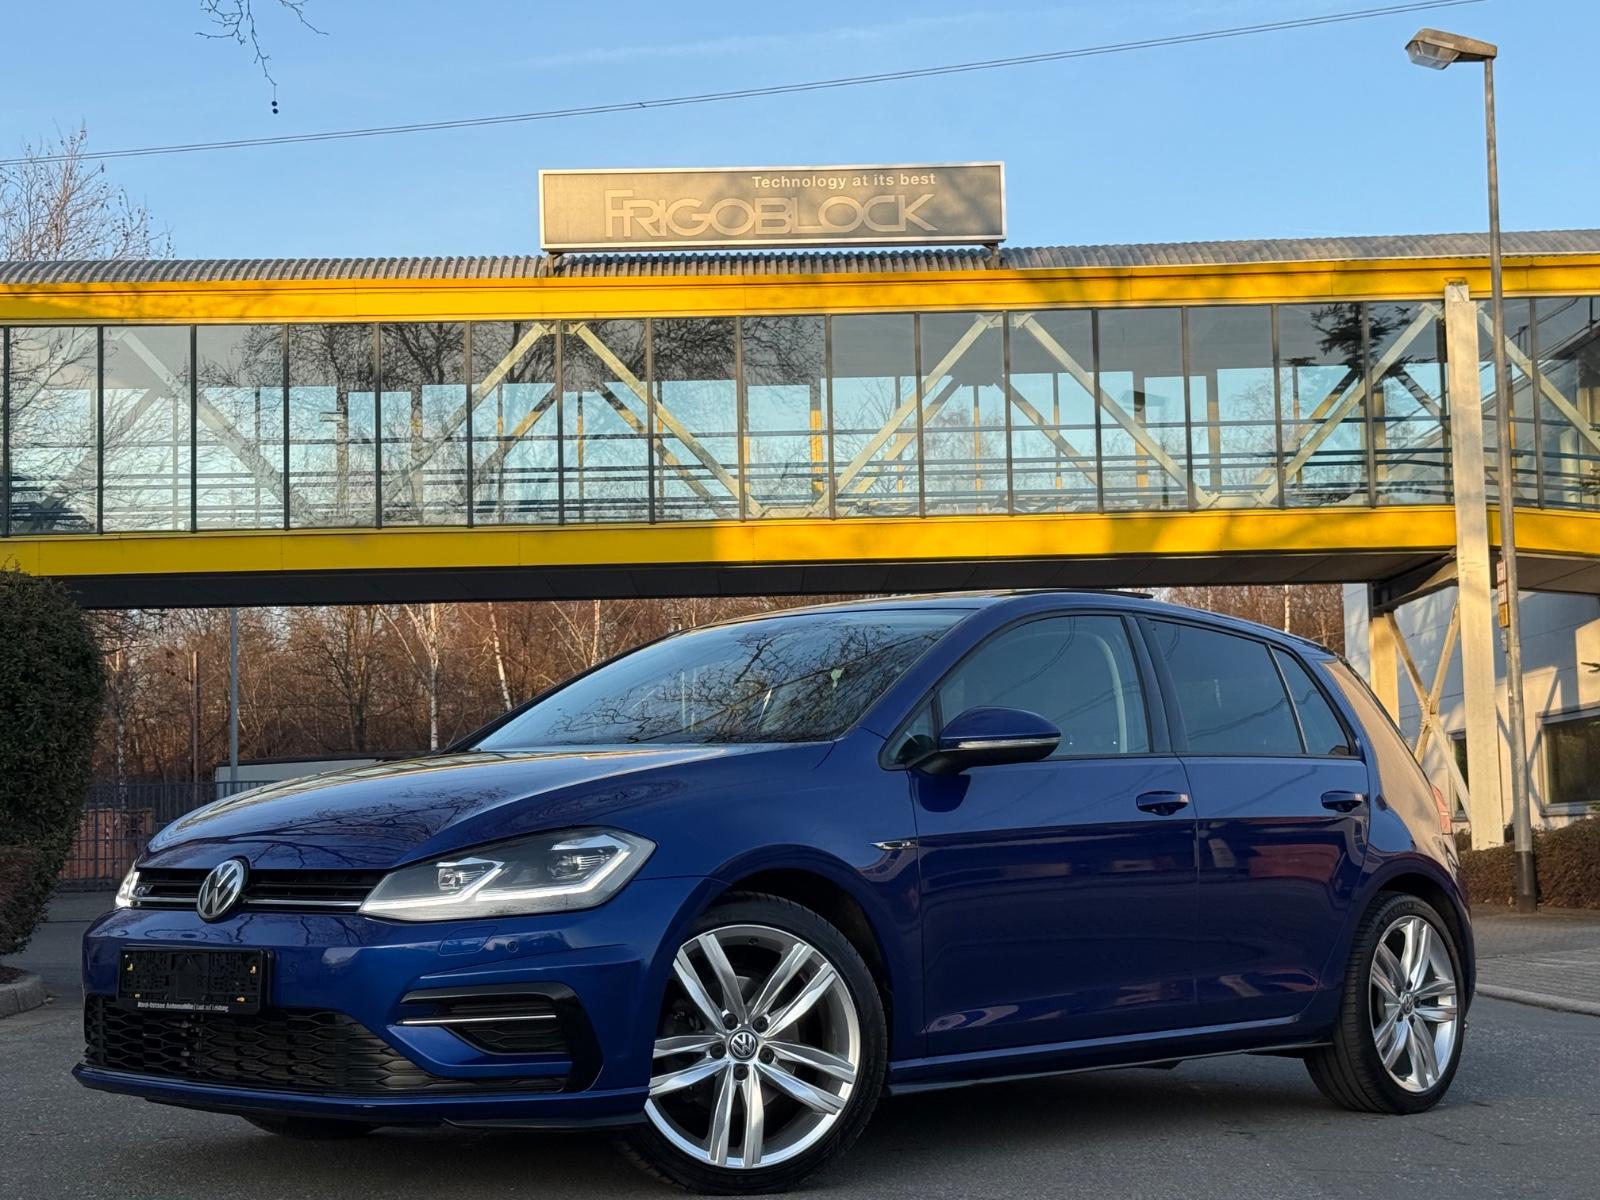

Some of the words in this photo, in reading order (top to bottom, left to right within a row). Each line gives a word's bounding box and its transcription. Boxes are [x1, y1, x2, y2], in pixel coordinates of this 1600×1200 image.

[752, 175, 847, 190] Technology
[852, 175, 869, 187] at
[873, 174, 894, 186] its
[899, 172, 936, 185] best
[604, 189, 938, 237] FRIGOBLOCK
